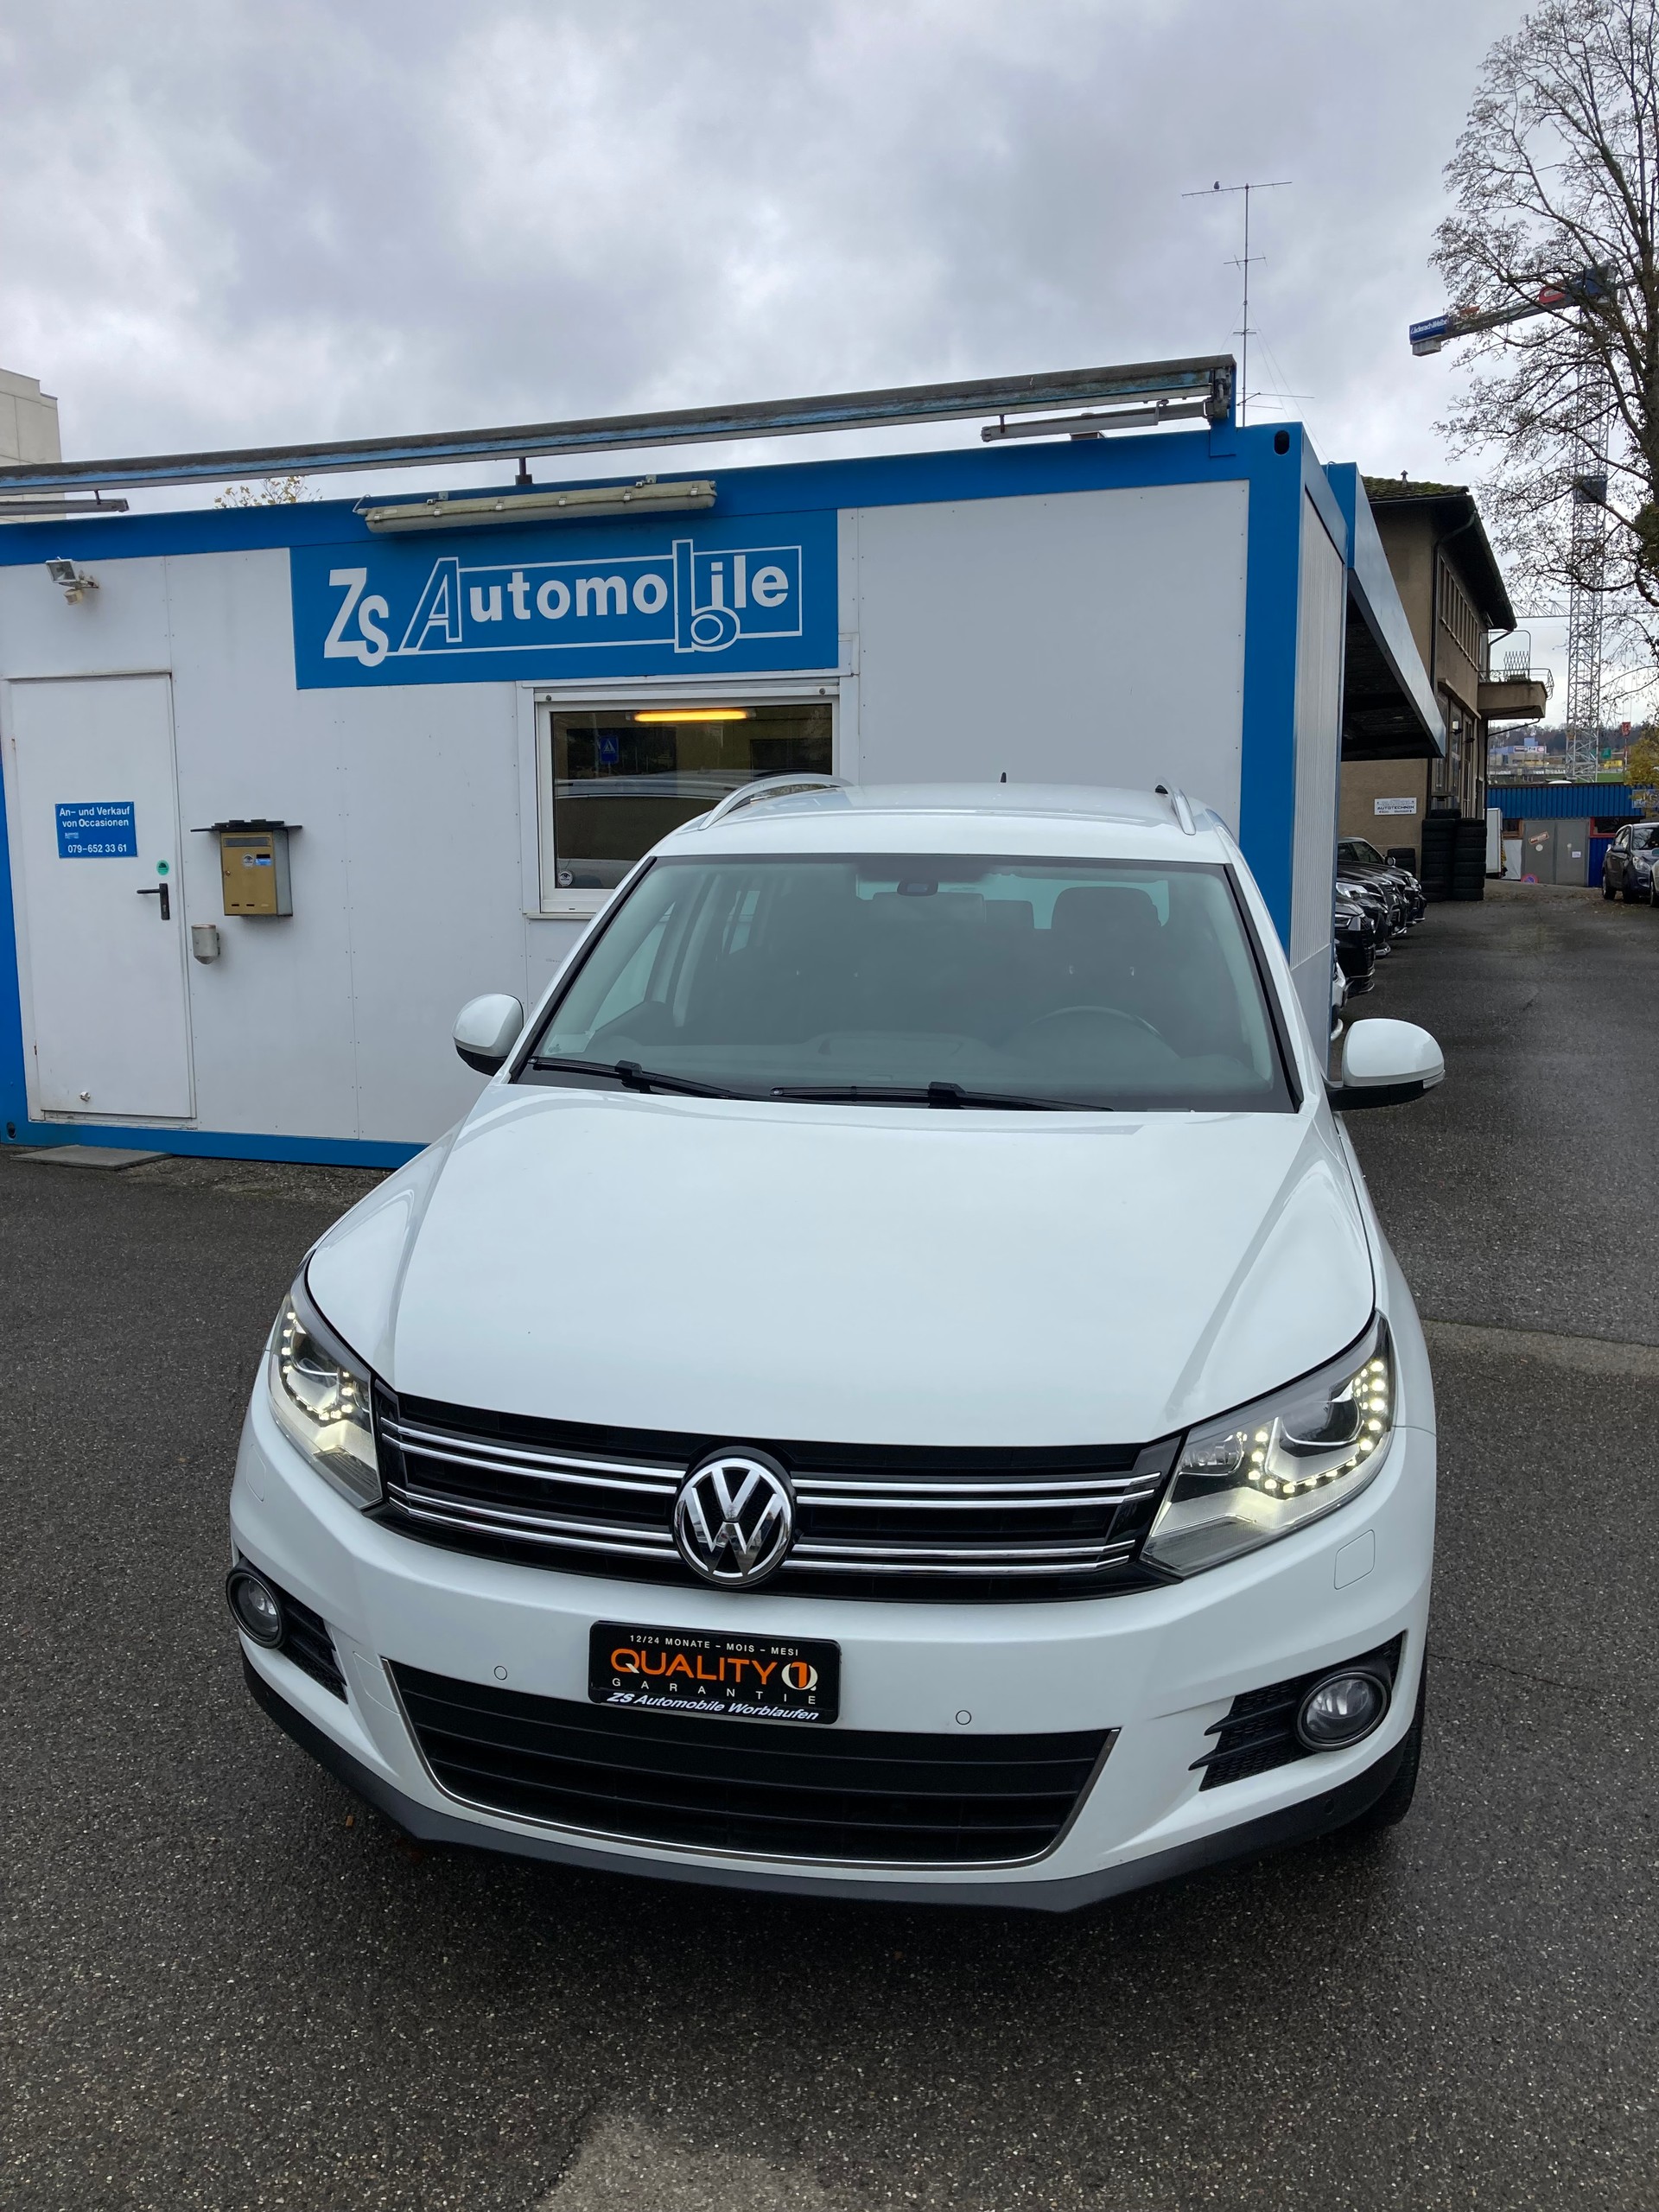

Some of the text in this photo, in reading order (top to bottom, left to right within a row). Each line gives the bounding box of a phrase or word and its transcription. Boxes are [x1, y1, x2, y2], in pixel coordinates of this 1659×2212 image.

[397, 538, 790, 654] Automobile
[59, 805, 130, 817] An- und Verkauf
[79, 817, 130, 828] Occasionen
[67, 843, 127, 854] 079-652 33 61
[629, 1634, 660, 1644] 12/24
[664, 1637, 711, 1649] MONATE
[726, 1643, 755, 1653] MOIS
[771, 1646, 798, 1656] MESI
[610, 1648, 779, 1686] QUALITY
[612, 1677, 817, 1705] GARANTIE
[607, 1692, 820, 1720] ZS Automobile Worblaufen
